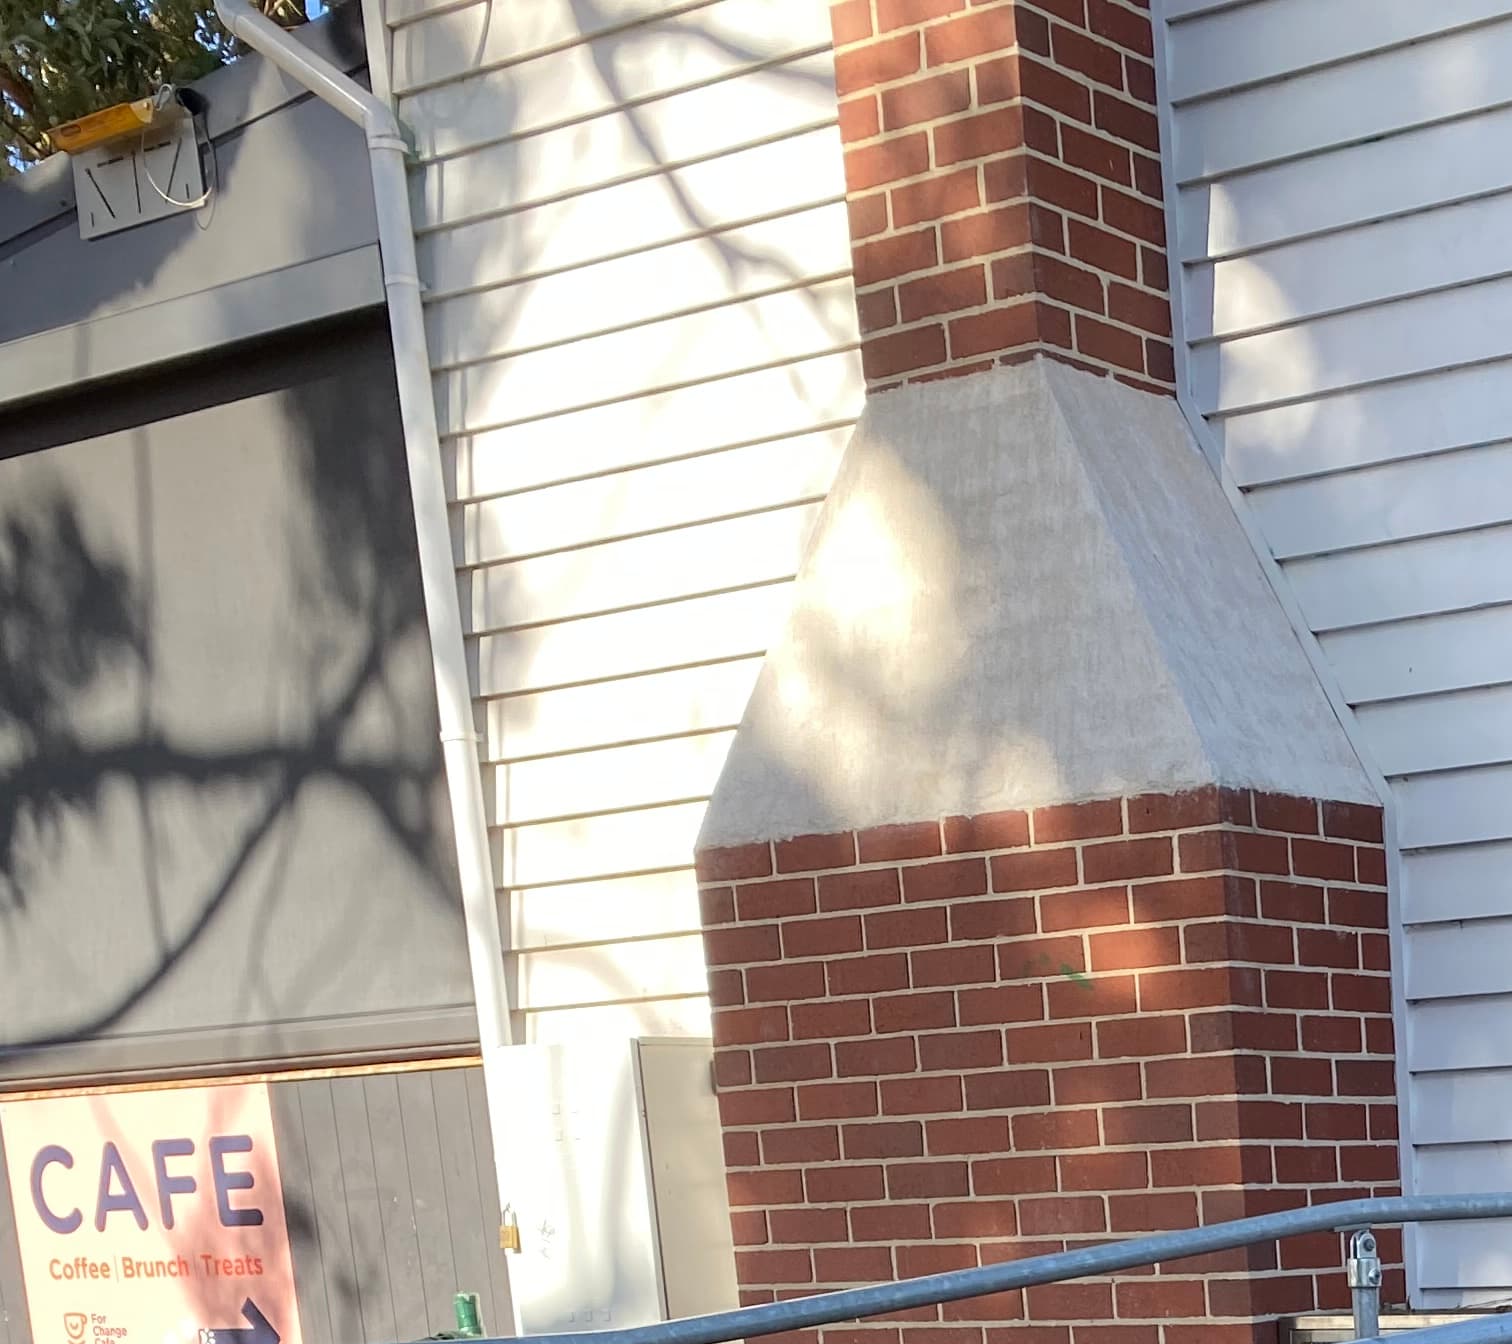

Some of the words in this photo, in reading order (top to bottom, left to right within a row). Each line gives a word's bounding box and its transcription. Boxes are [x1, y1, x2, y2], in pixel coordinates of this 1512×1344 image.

[30, 1134, 264, 1235] CAFE
[49, 1256, 111, 1280] Coffee
[121, 1255, 190, 1279] Brunch
[200, 1253, 264, 1276] Treats
[91, 1313, 107, 1324] For
[93, 1326, 128, 1338] Change
